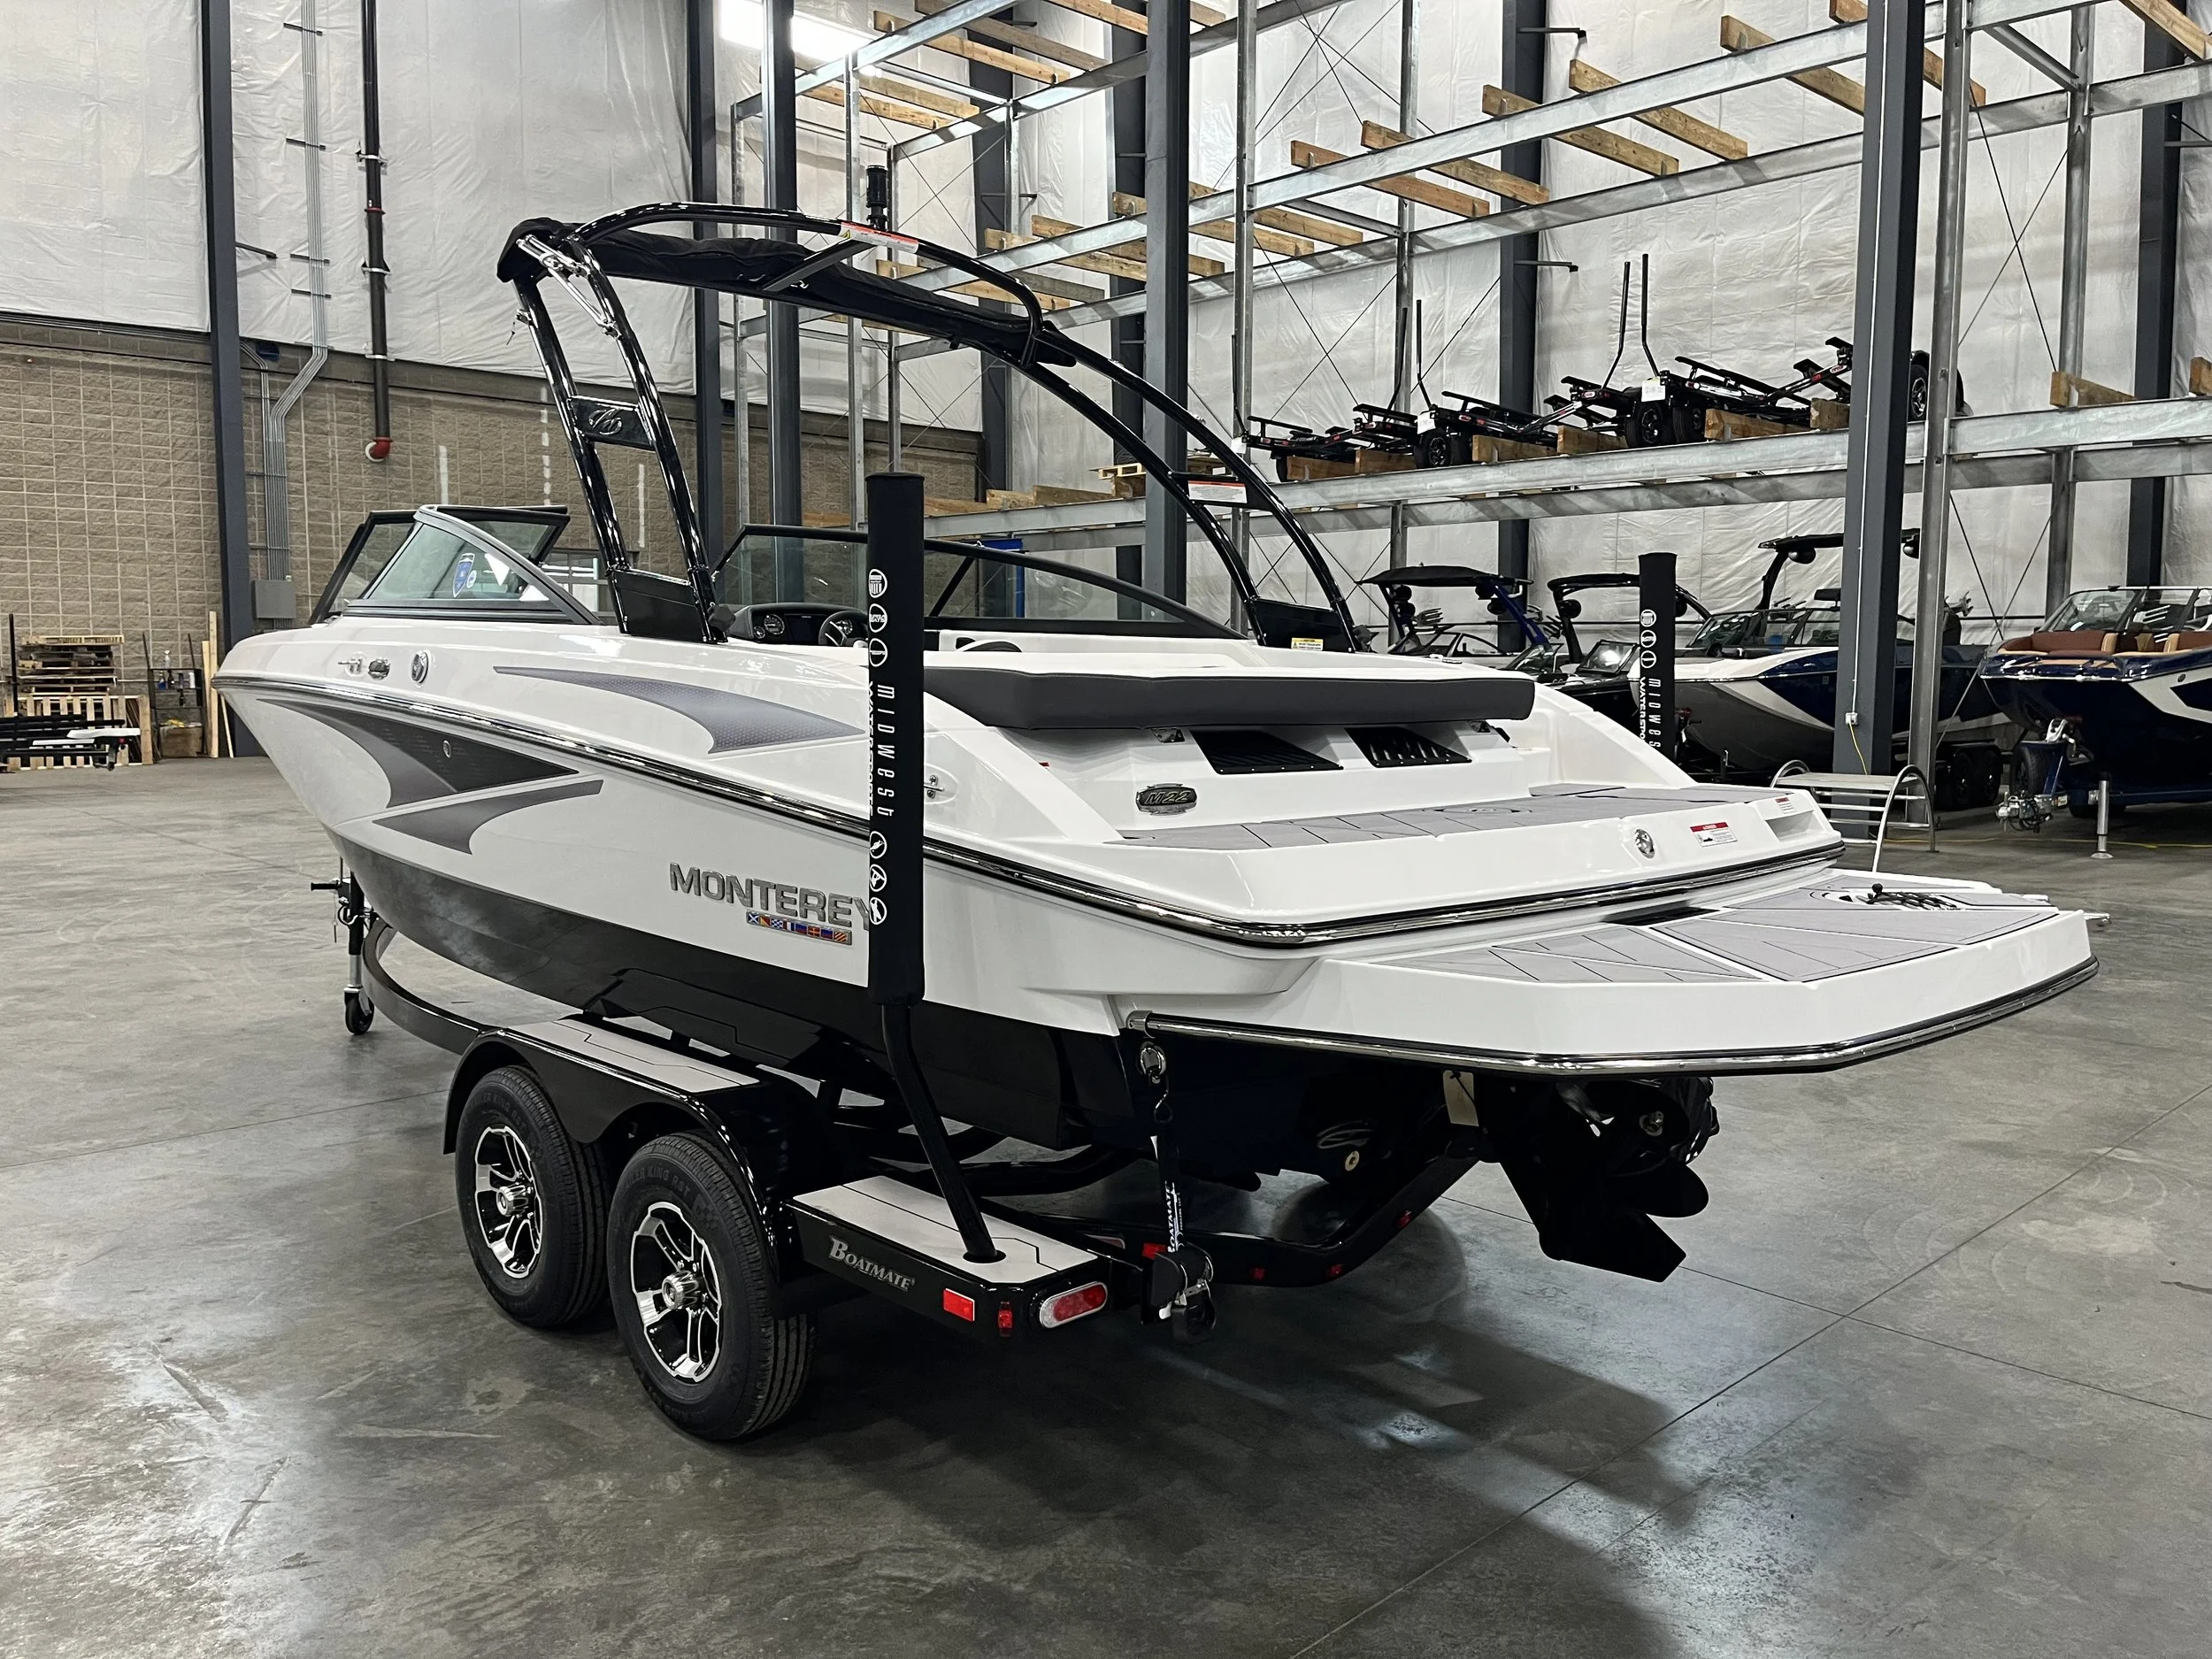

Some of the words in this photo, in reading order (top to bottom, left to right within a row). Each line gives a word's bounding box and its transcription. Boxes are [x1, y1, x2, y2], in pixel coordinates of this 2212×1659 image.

[1144, 790, 1191, 805] M22
[669, 862, 869, 931] MONTEREY
[647, 1164, 670, 1181] KING
[828, 1236, 911, 1291] BOATMATE
